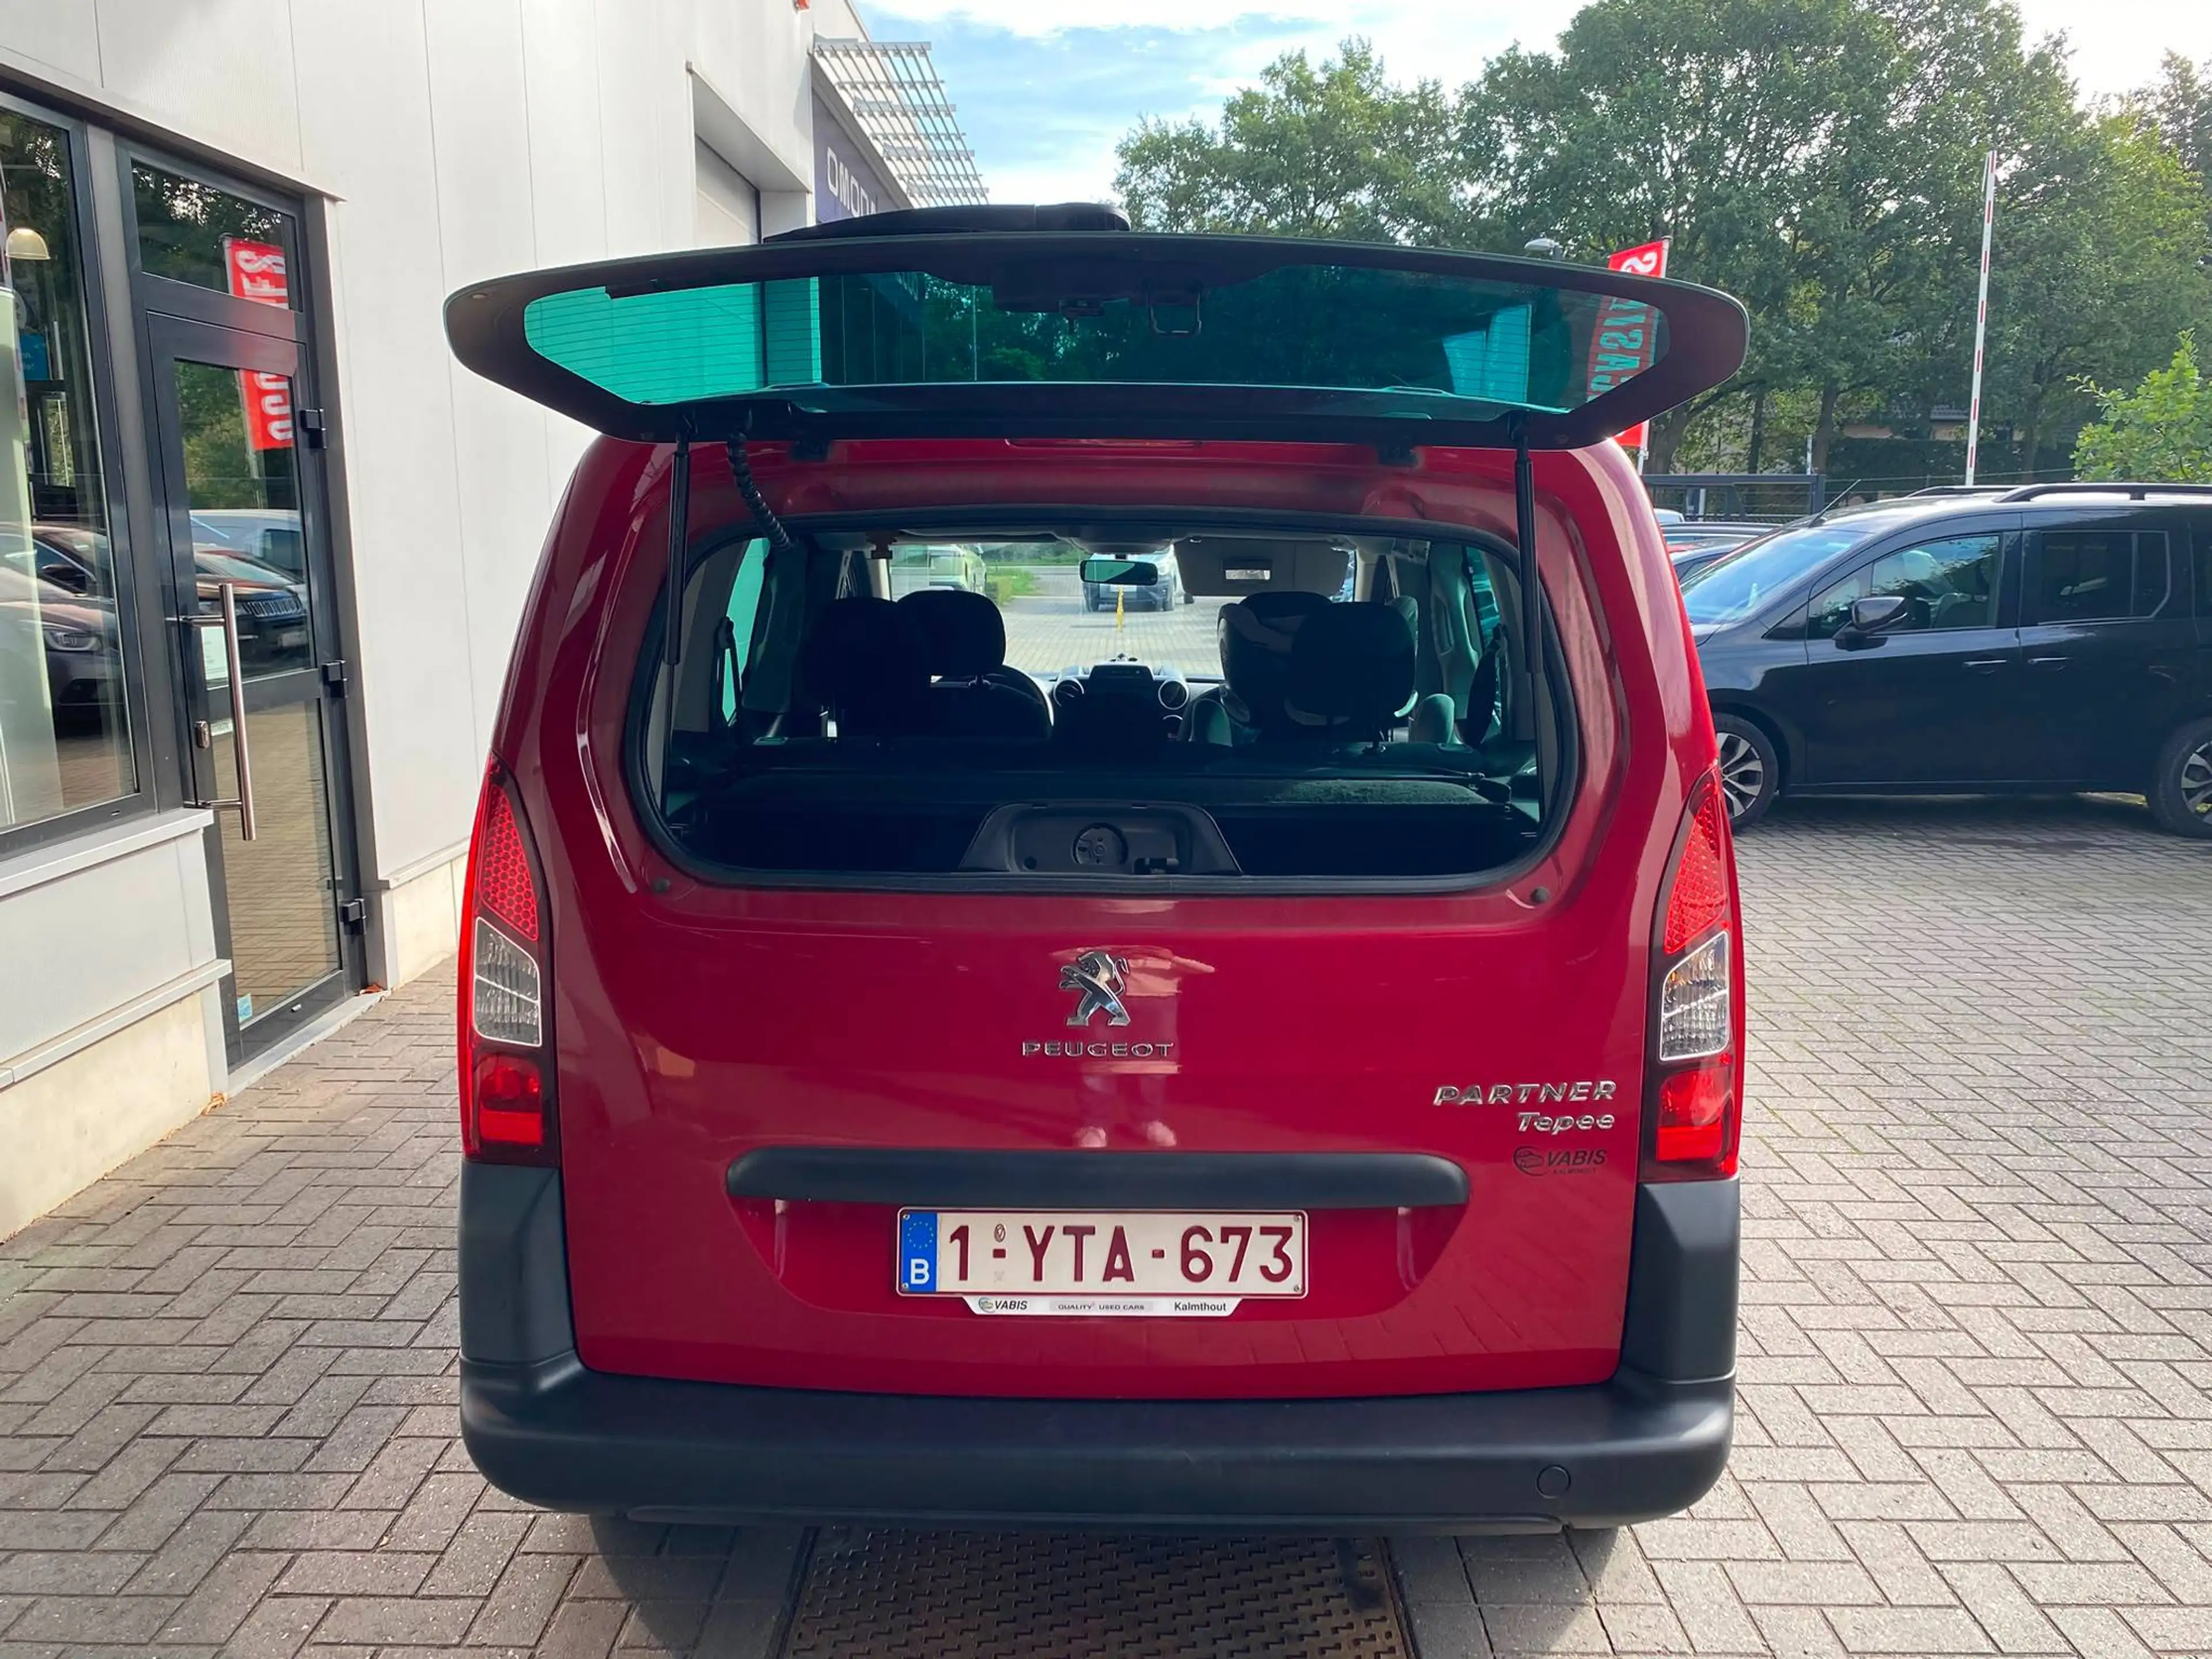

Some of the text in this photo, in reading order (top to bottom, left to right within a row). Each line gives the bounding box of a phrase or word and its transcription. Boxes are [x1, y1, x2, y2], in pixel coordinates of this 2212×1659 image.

[1022, 1041, 1174, 1058] PEUGEOT
[1433, 1081, 1618, 1105] PARTNER
[1517, 1112, 1615, 1135] Tepee
[1547, 1149, 1607, 1166] VABIS
[950, 1225, 1293, 1282] 1-YTA-673
[911, 1259, 929, 1284] B
[995, 1300, 1028, 1310] VABIS
[1175, 1301, 1226, 1312] Kalmthout
